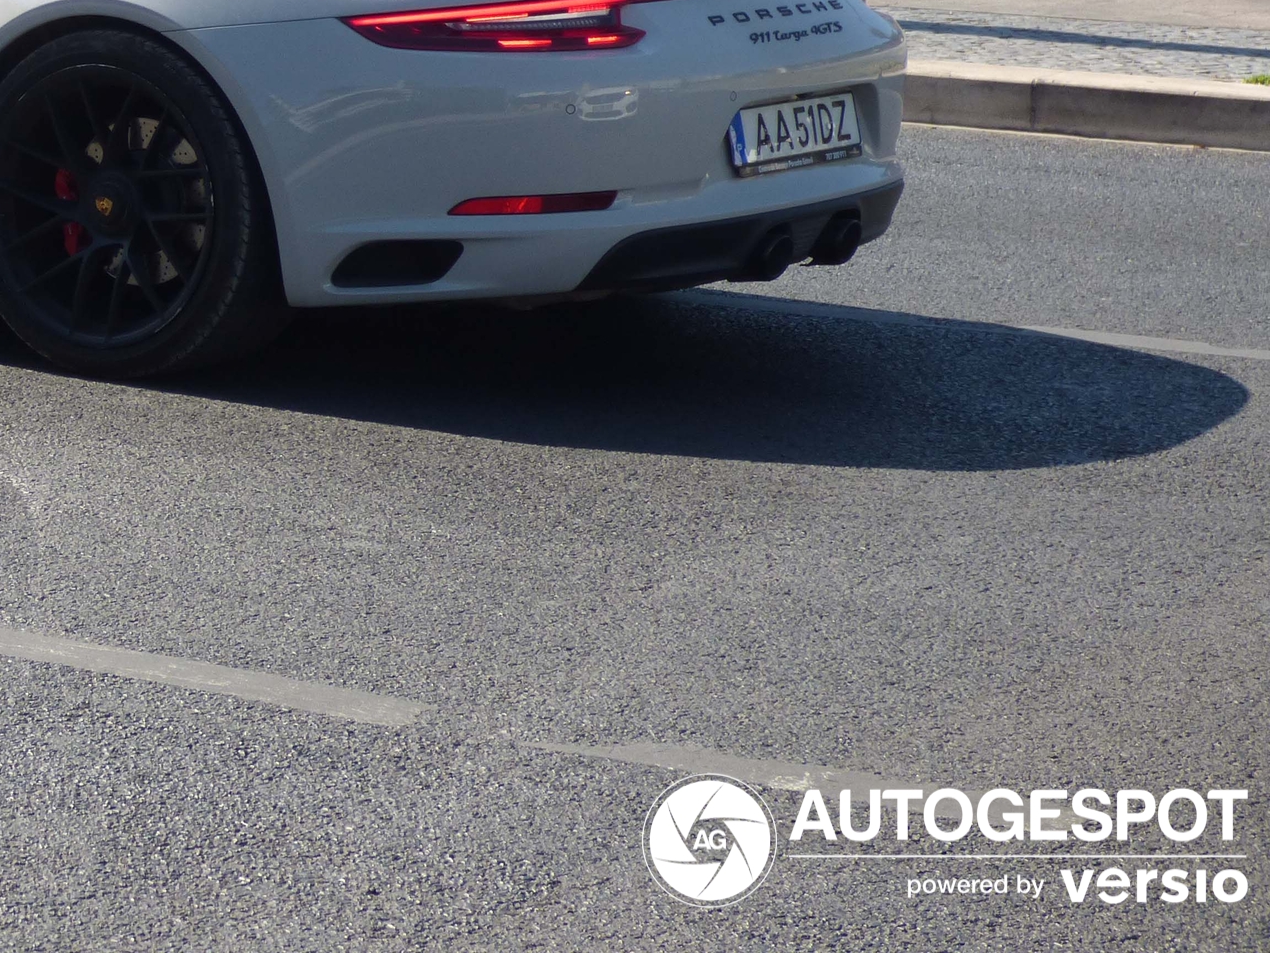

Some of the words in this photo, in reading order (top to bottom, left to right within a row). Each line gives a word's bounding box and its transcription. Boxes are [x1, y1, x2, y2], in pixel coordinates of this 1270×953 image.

[707, 0, 844, 27] PORSCHE
[749, 31, 771, 45] 911
[756, 99, 851, 156] AA51DZ
